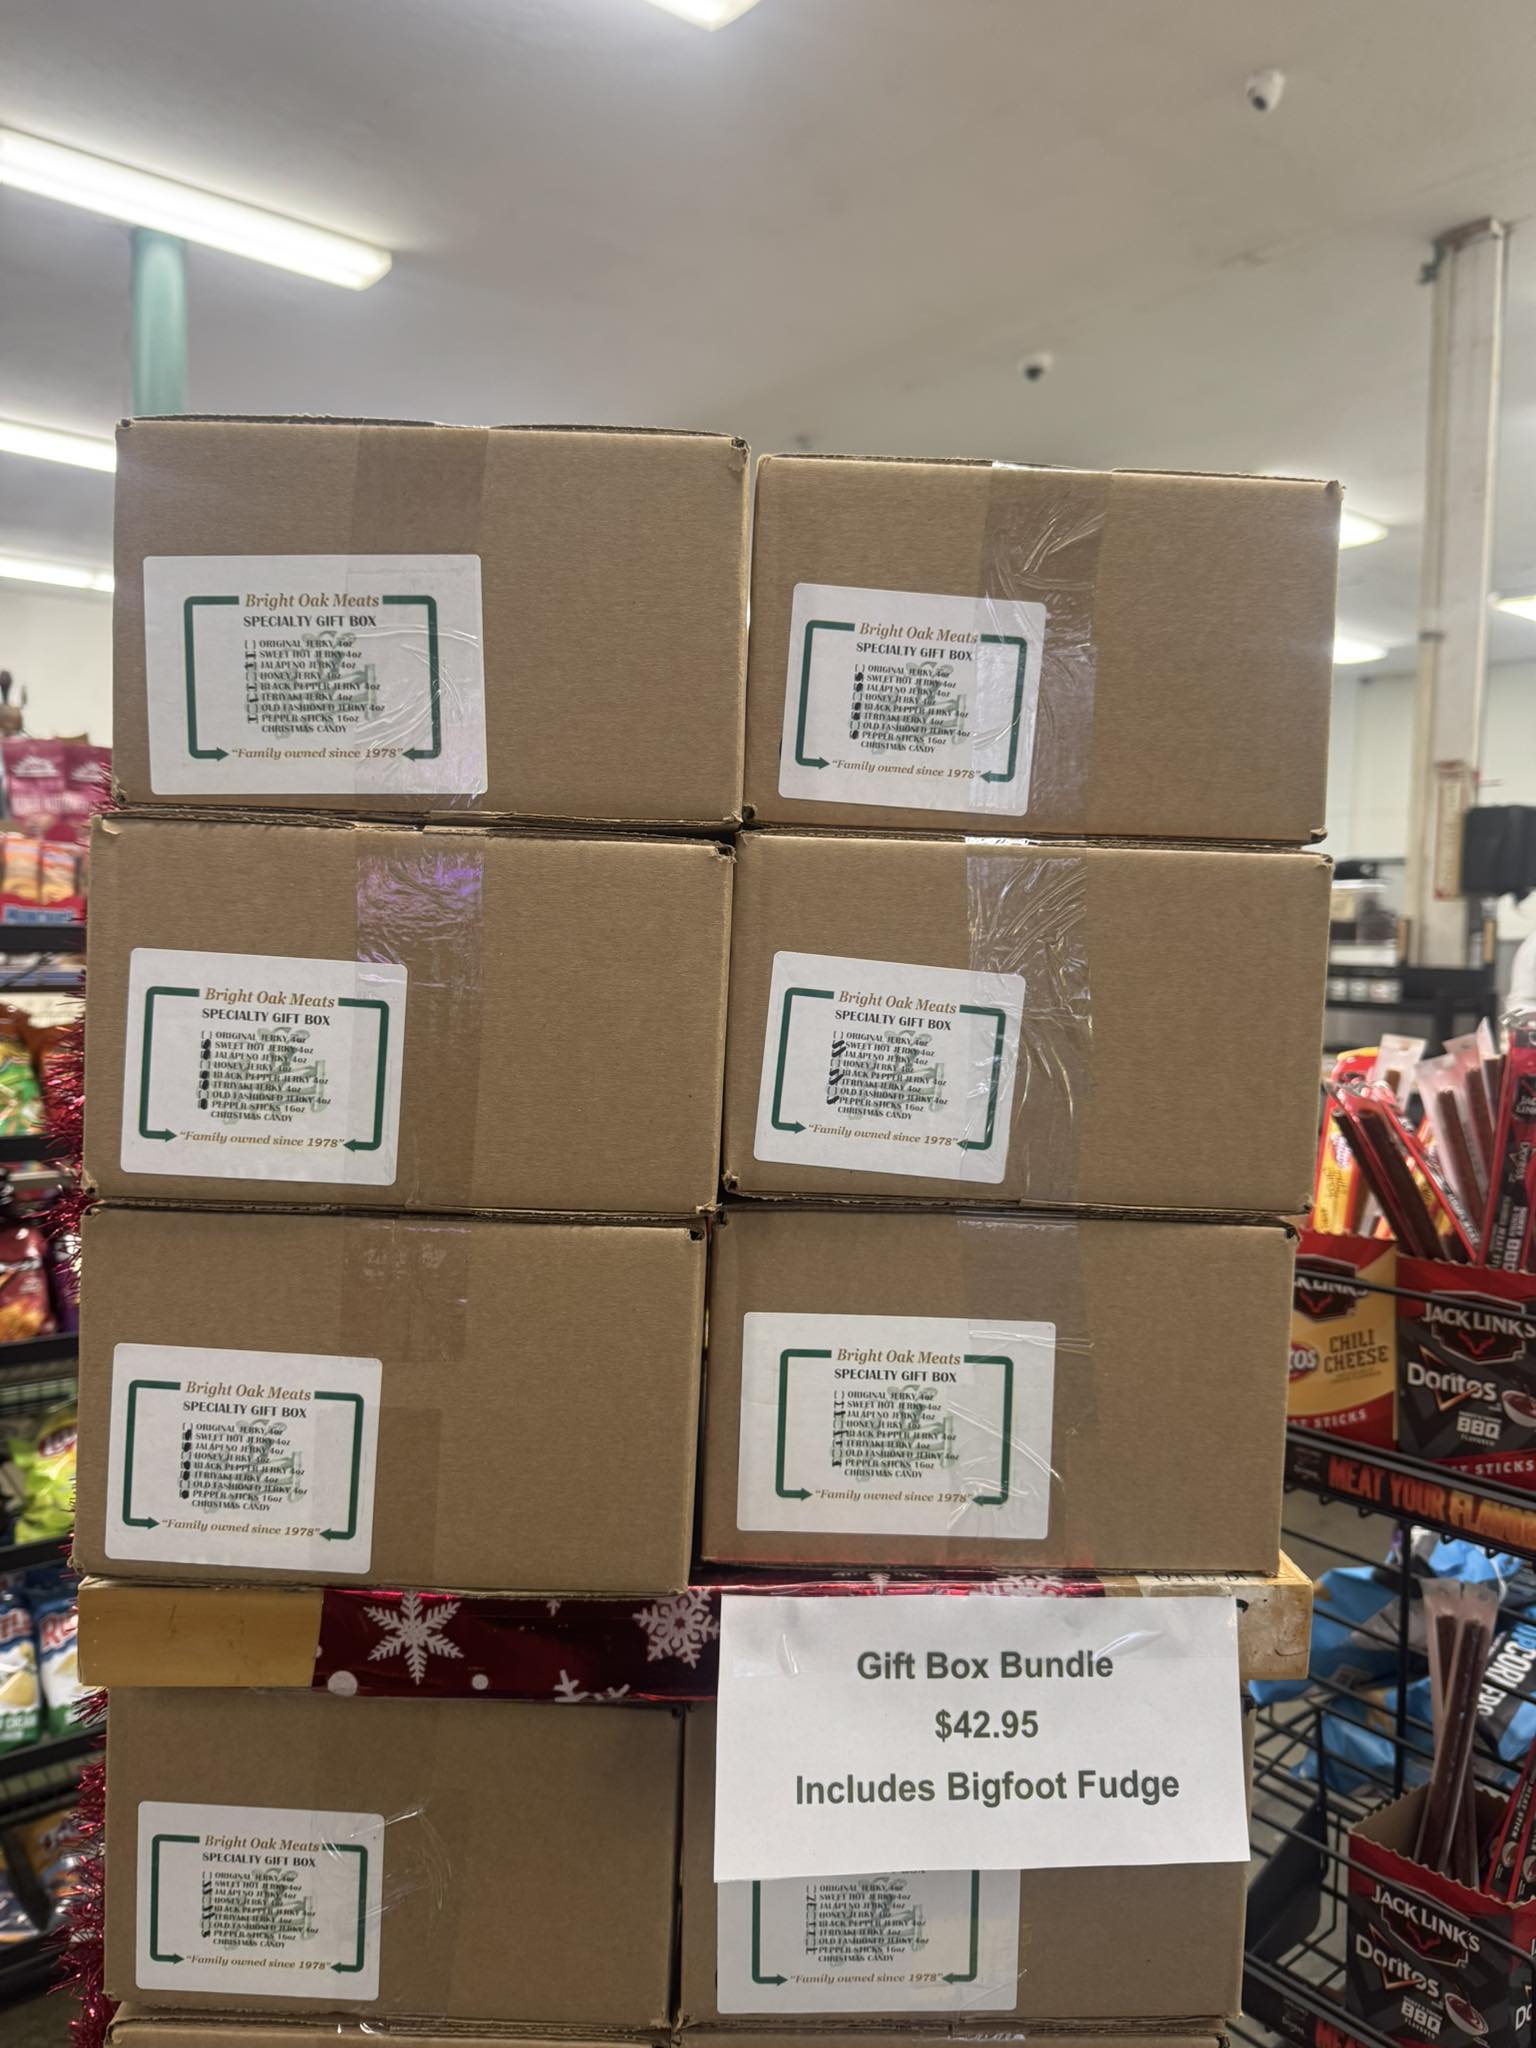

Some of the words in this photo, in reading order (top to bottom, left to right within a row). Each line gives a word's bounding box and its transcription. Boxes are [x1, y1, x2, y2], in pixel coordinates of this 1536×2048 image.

[245, 593, 294, 610] Bright
[298, 593, 328, 607] Oak
[332, 593, 379, 607] Meats
[242, 615, 311, 626] SPECIALTY
[316, 615, 345, 626] GIFT
[349, 615, 376, 626] BOX
[859, 622, 903, 640] Bright
[906, 625, 933, 640] Oak
[936, 628, 978, 643] Meats
[855, 641, 916, 656] SPECIALTY
[919, 646, 945, 659] GIFT
[948, 649, 973, 661] BOX
[261, 725, 313, 733] CHRISTMAS
[316, 725, 346, 733] CANDY
[283, 747, 325, 758] owned
[328, 747, 360, 758] since
[860, 740, 906, 751] CHRISTMAS
[908, 744, 935, 753] CANDY
[877, 762, 913, 774] owned
[915, 765, 944, 776] since
[205, 987, 253, 1005] Bright
[257, 990, 286, 1004] Oak
[289, 992, 335, 1007] Meats
[838, 990, 883, 1009] Bright
[885, 994, 912, 1009] Oak
[915, 998, 957, 1014] Meats
[201, 1007, 268, 1022] SPECIALTY
[272, 1012, 300, 1024] GIFT
[304, 1013, 330, 1026] BOX
[834, 1009, 895, 1025] SPECIALTY
[898, 1015, 924, 1028] GIFT
[927, 1018, 952, 1031] BOX
[210, 1110, 261, 1120] CHRISTMAS
[263, 1113, 292, 1122] CANDY
[837, 1106, 883, 1117] CHRISTMAS
[885, 1110, 912, 1120] CANDY
[230, 1132, 270, 1144] owned
[272, 1135, 304, 1146] since
[853, 1127, 890, 1140] owned
[892, 1131, 921, 1143] since
[1422, 1302, 1471, 1329] JACK
[1328, 1329, 1375, 1354] CHILI
[837, 1348, 882, 1365] Bright
[886, 1349, 914, 1363] Oak
[917, 1351, 961, 1364] Meats
[1323, 1345, 1389, 1374] CHEESE
[833, 1368, 897, 1380] SPECIALTY
[901, 1370, 928, 1381] GIFT
[931, 1371, 957, 1382] BOX
[1407, 1361, 1498, 1402] Doritos
[186, 1380, 232, 1398] Bright
[236, 1383, 264, 1397] Oak
[267, 1386, 311, 1401] Meats
[182, 1400, 247, 1414] SPECIALTY
[250, 1404, 277, 1416] GIFT
[281, 1406, 307, 1418] BOX
[1314, 1408, 1367, 1429] STICKS
[1456, 1416, 1501, 1440] BBQ
[843, 1468, 892, 1477] CHRISTMAS
[894, 1470, 922, 1478] CANDY
[1475, 1459, 1535, 1475] STICKS
[863, 1490, 901, 1501] owned
[904, 1491, 934, 1502] since
[1328, 1456, 1384, 1501] MEAT
[1388, 1473, 1446, 1521] YOUR
[191, 1499, 240, 1509] CHRISTMAS
[242, 1502, 270, 1511] CANDY
[210, 1521, 248, 1533] owned
[251, 1523, 281, 1534] since
[856, 1650, 916, 1679] Gift
[926, 1652, 990, 1679] Box
[1001, 1650, 1114, 1678] Bundle
[935, 1710, 1039, 1741] $42.95
[796, 1774, 936, 1804] Includes
[948, 1771, 1067, 1808] Bigfoot
[1078, 1769, 1180, 1804] Fudge
[205, 1834, 247, 1850] Bright
[250, 1837, 276, 1849] Oak
[279, 1839, 319, 1852] Meats
[202, 1852, 261, 1864] SPECIALTY
[264, 1855, 289, 1865] GIFT
[293, 1857, 316, 1867] BOX
[1371, 1885, 1420, 1924] JACK
[1421, 1907, 1480, 1952] LINK'S
[212, 1938, 257, 1947] CHRISTMAS
[259, 1940, 285, 1948] CANDY
[230, 1957, 266, 1966] owned
[268, 1958, 295, 1968] since
[1356, 1933, 1440, 1998] Doritos
[837, 1973, 874, 1982] owned
[876, 1973, 905, 1982] since
[1401, 2001, 1442, 2034] BBQ
